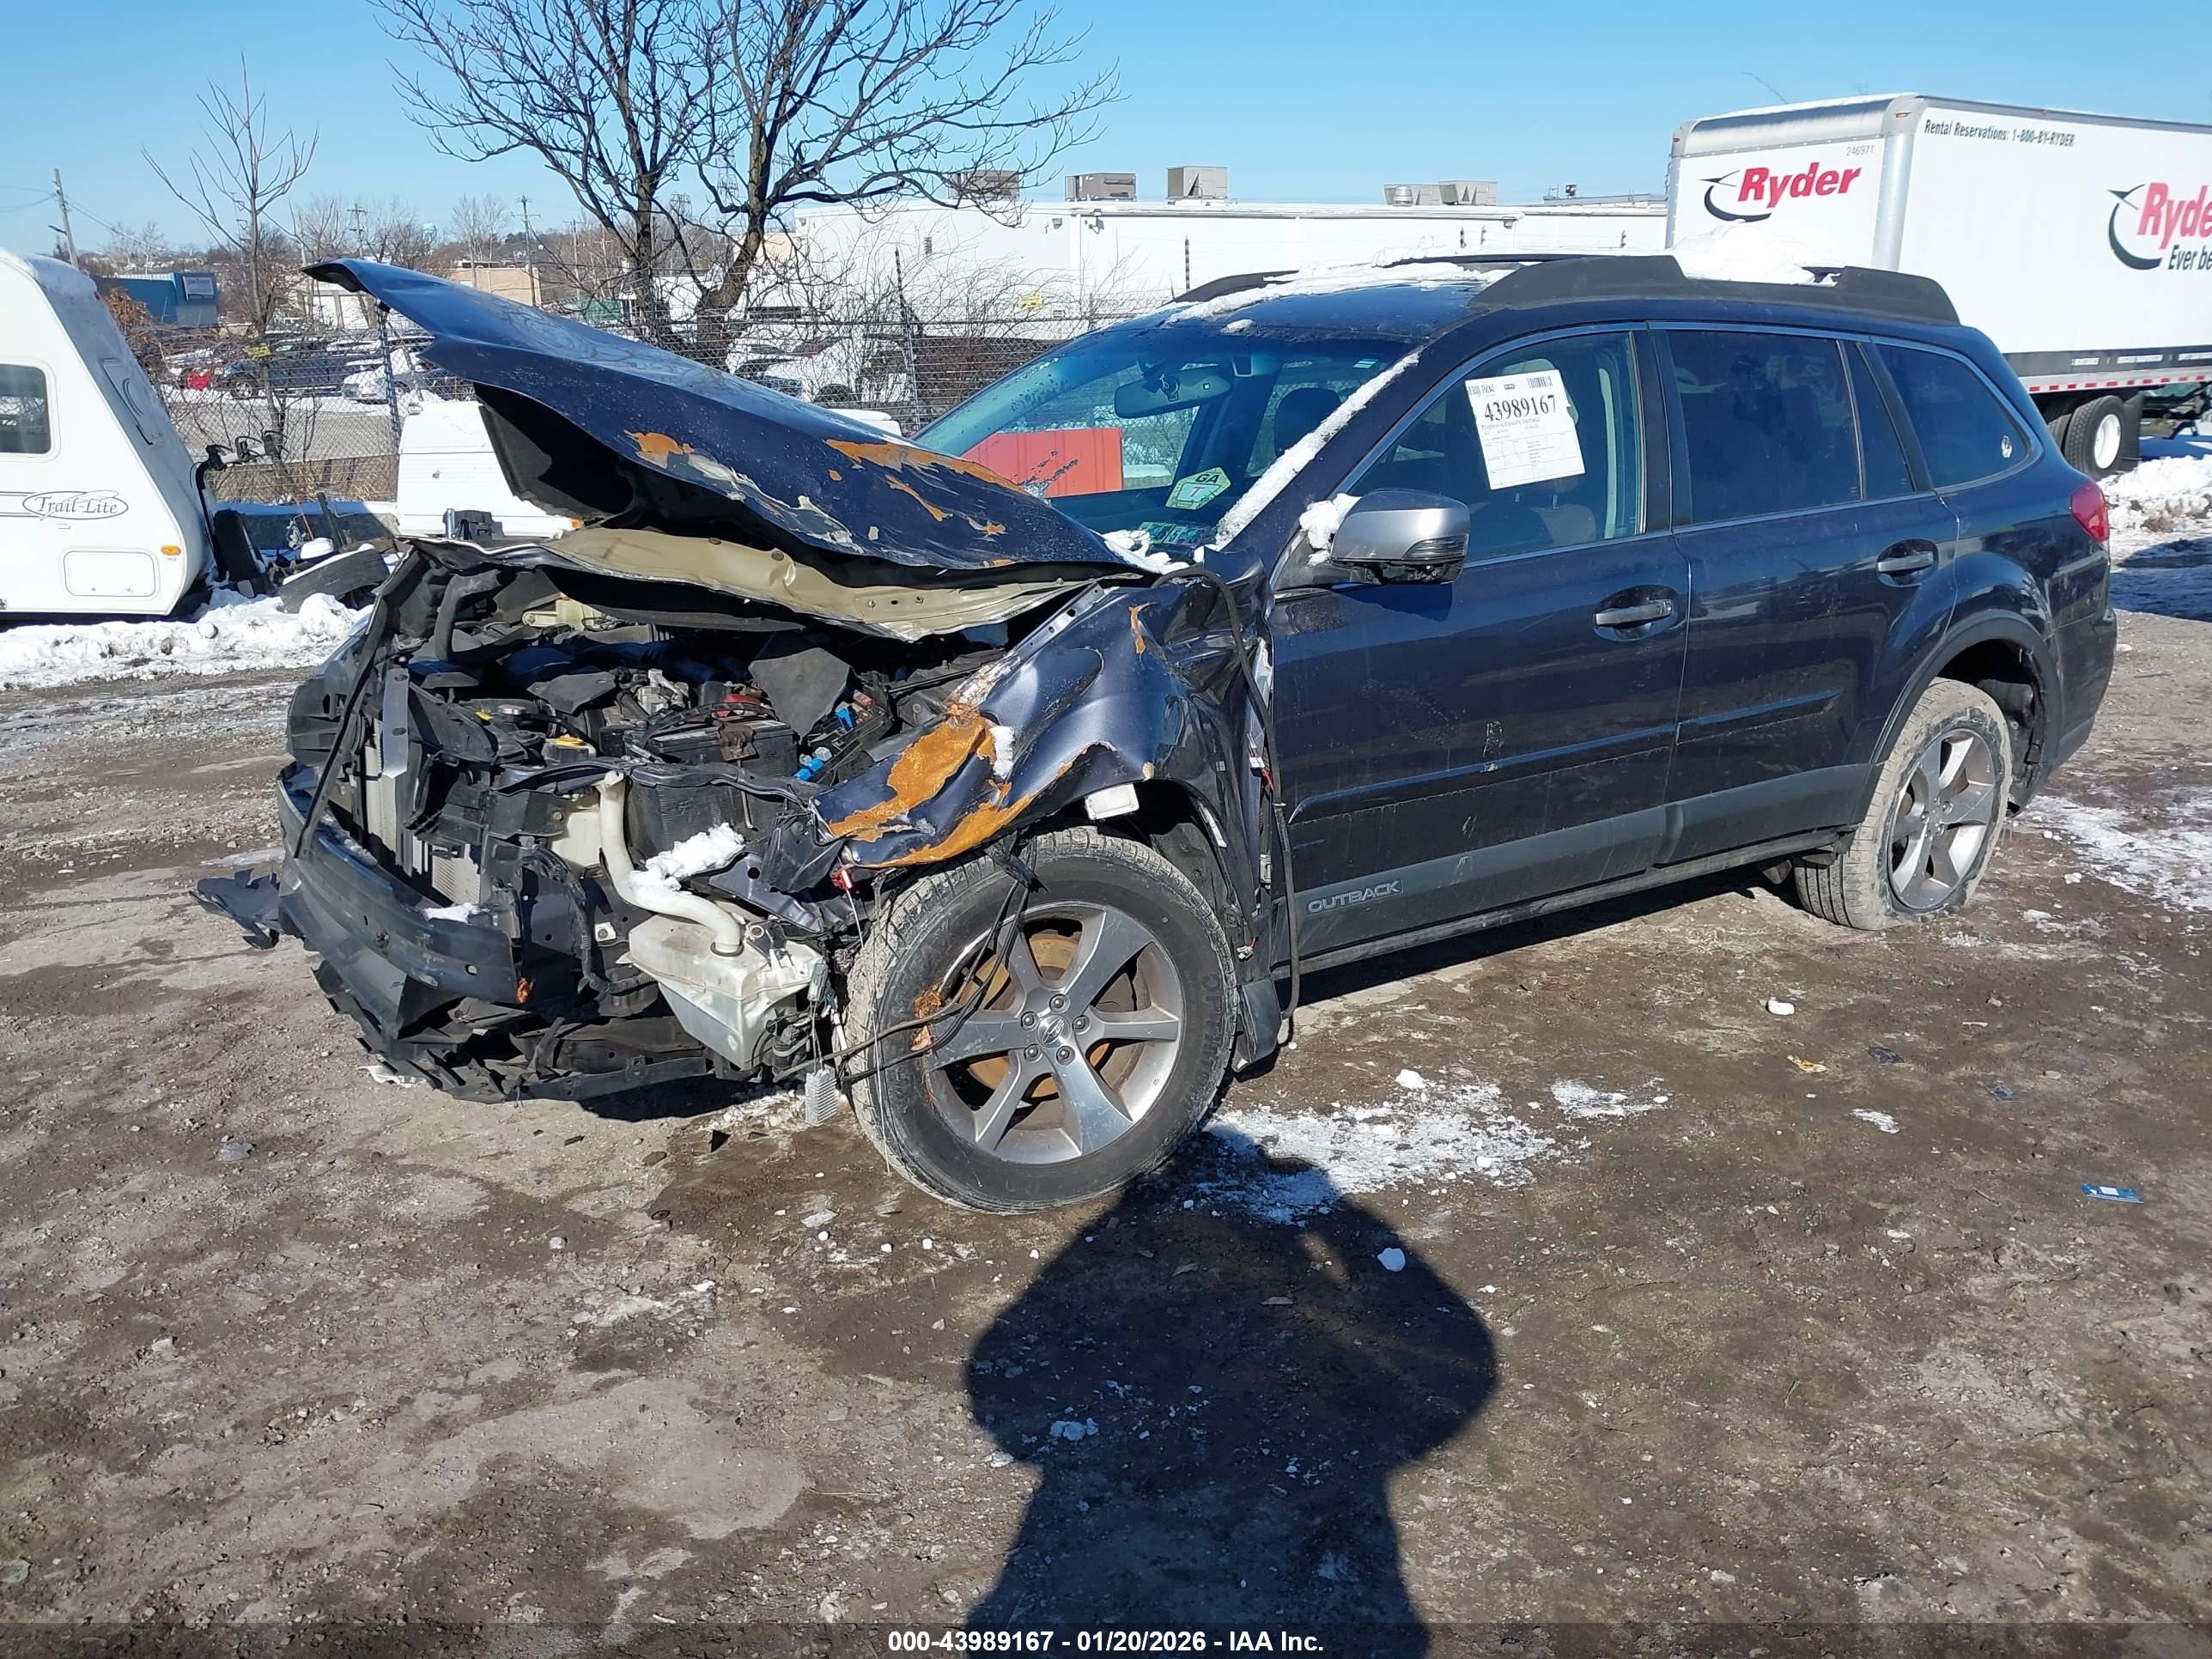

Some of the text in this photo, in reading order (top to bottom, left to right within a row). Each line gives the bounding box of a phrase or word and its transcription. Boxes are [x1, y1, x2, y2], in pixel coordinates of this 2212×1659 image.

[1923, 119, 1954, 135] Rental
[1954, 122, 2009, 141] Reservations:
[1737, 161, 1862, 209] Ryder
[2167, 245, 2198, 270] Ever
[1485, 394, 1556, 422] 43989167
[1308, 880, 1401, 913] OUTBACK
